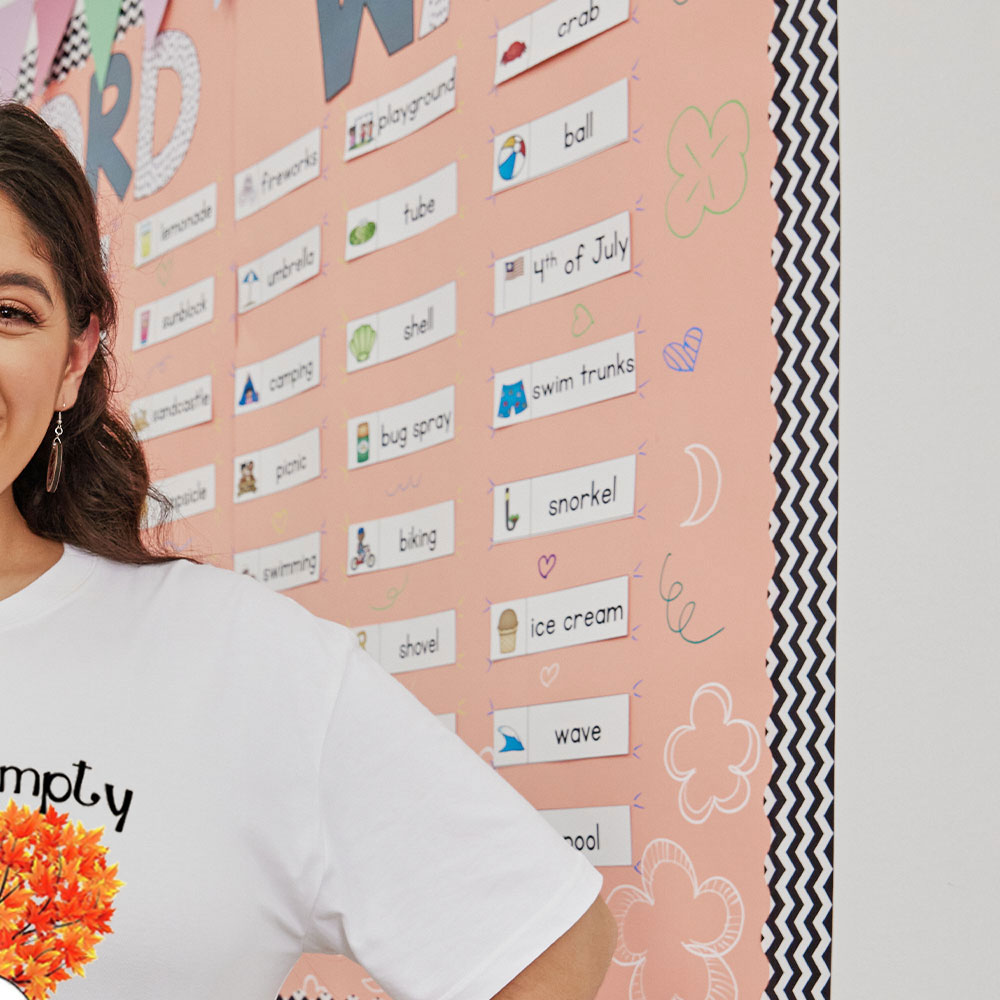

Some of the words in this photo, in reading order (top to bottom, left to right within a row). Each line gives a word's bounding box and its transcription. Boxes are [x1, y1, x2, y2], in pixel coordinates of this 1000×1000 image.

[557, 0, 600, 37] crab
[378, 66, 456, 136] playground
[564, 111, 593, 148] ball
[404, 195, 436, 225] tube
[564, 244, 585, 274] of
[592, 231, 628, 265] July
[404, 306, 434, 341] shell
[532, 374, 574, 399] swim
[581, 353, 635, 386] trunks
[381, 424, 408, 448] bug
[413, 410, 451, 442] spray
[549, 475, 617, 516] snorkel
[400, 528, 437, 552] biking
[263, 553, 317, 581] swimming
[530, 618, 555, 639] ice
[563, 604, 624, 632] cream
[400, 628, 439, 659] shovel
[555, 724, 601, 745] wave
[563, 823, 600, 851] ool
